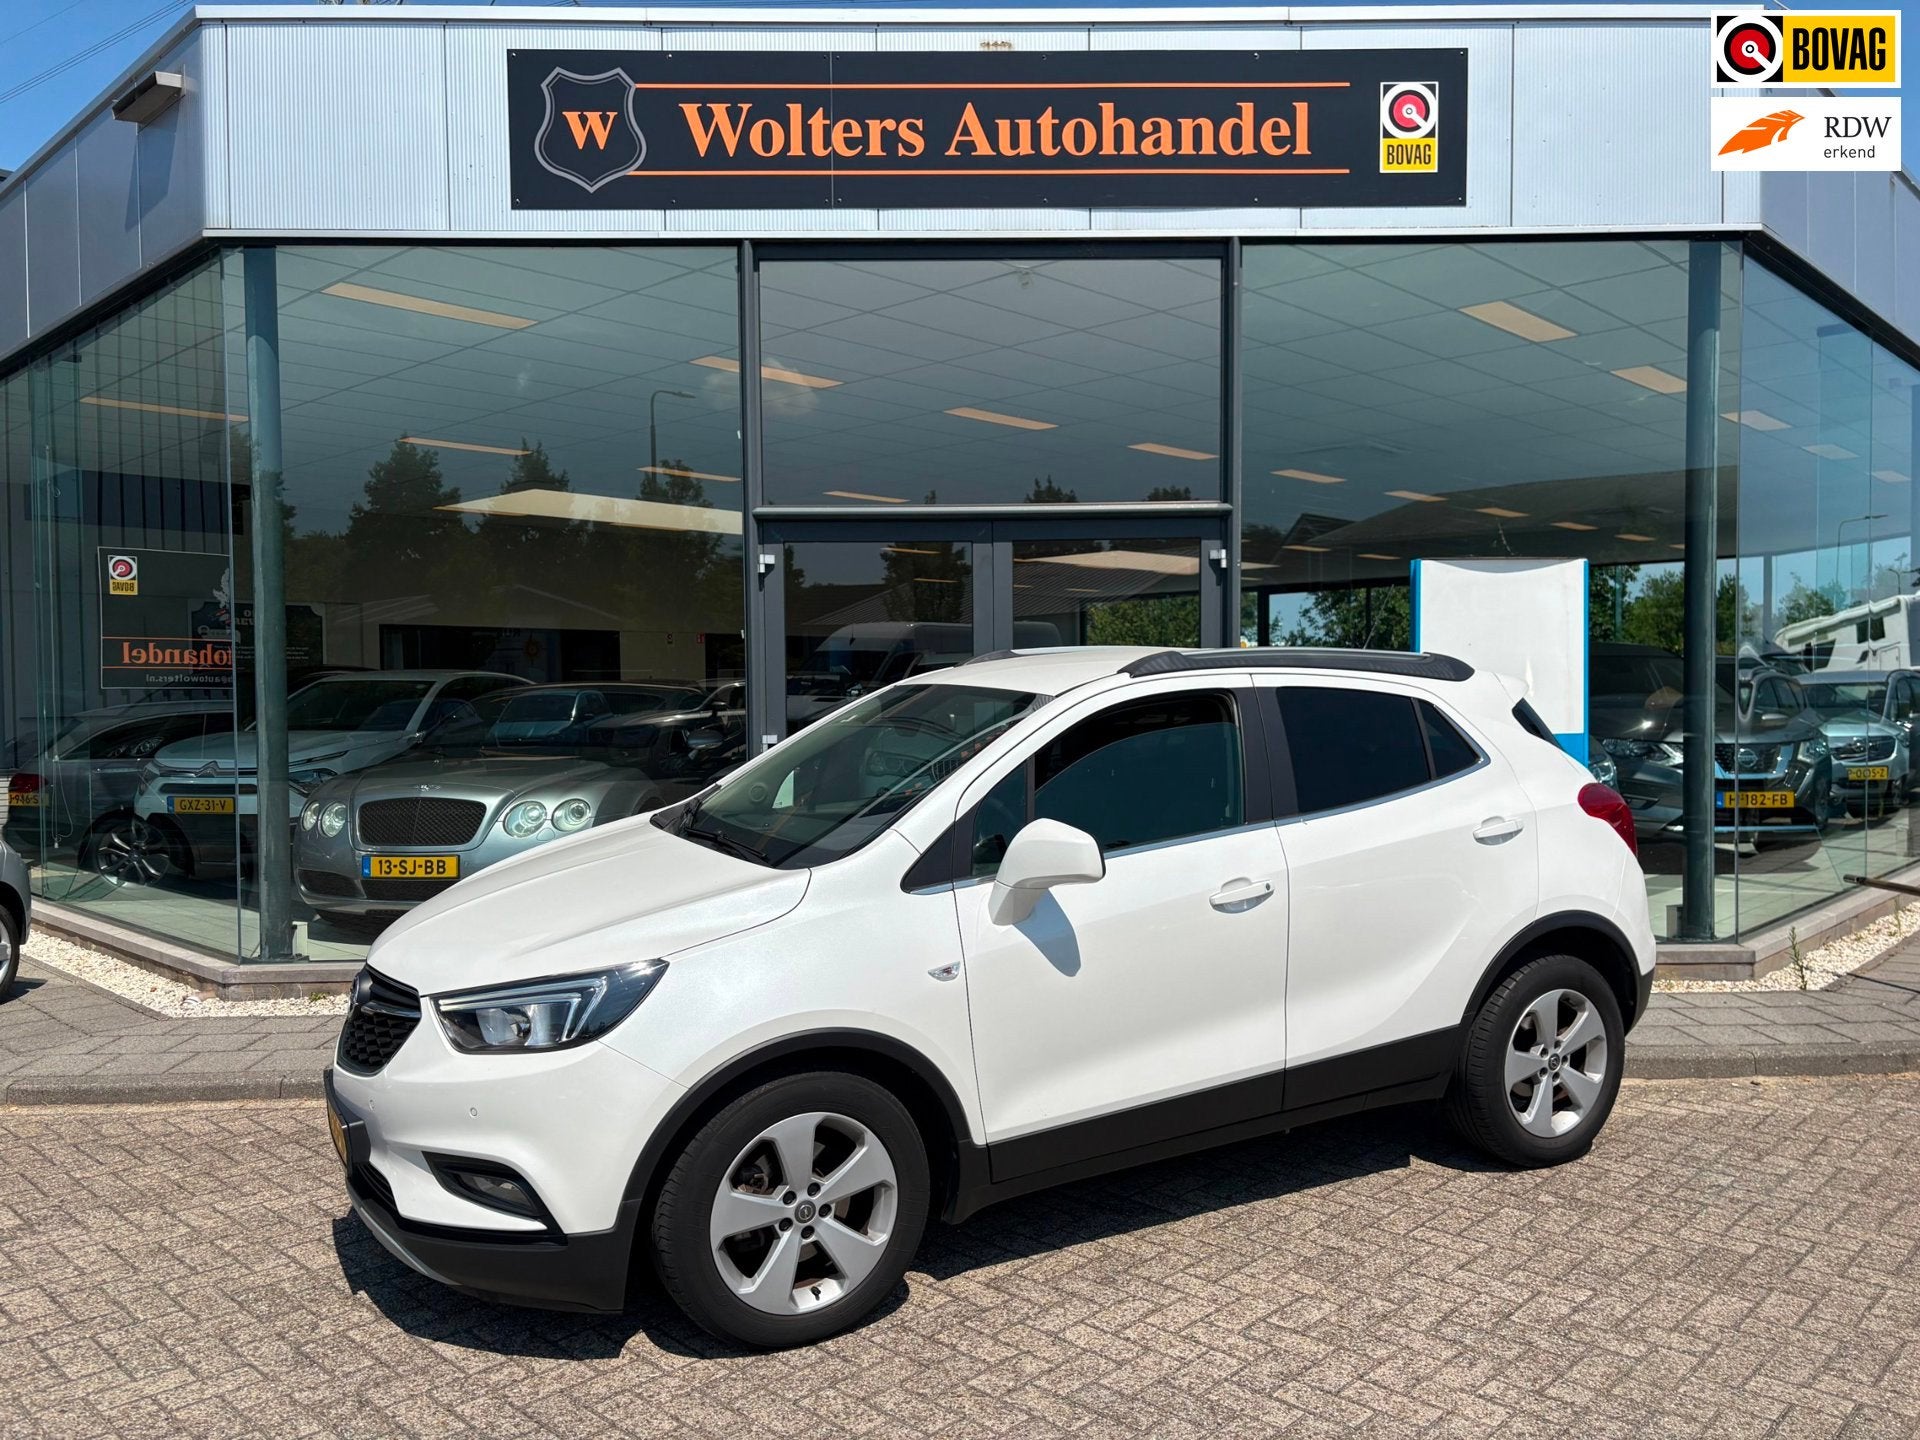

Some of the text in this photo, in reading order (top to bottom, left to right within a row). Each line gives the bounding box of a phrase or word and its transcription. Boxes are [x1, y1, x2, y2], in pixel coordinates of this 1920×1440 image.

[562, 111, 618, 150] W
[678, 101, 1312, 157] Wolters Autohandel
[1385, 142, 1432, 165] BOVAG
[179, 799, 226, 811] GXZ-31-V
[378, 859, 446, 875] 13-SJ-BB
